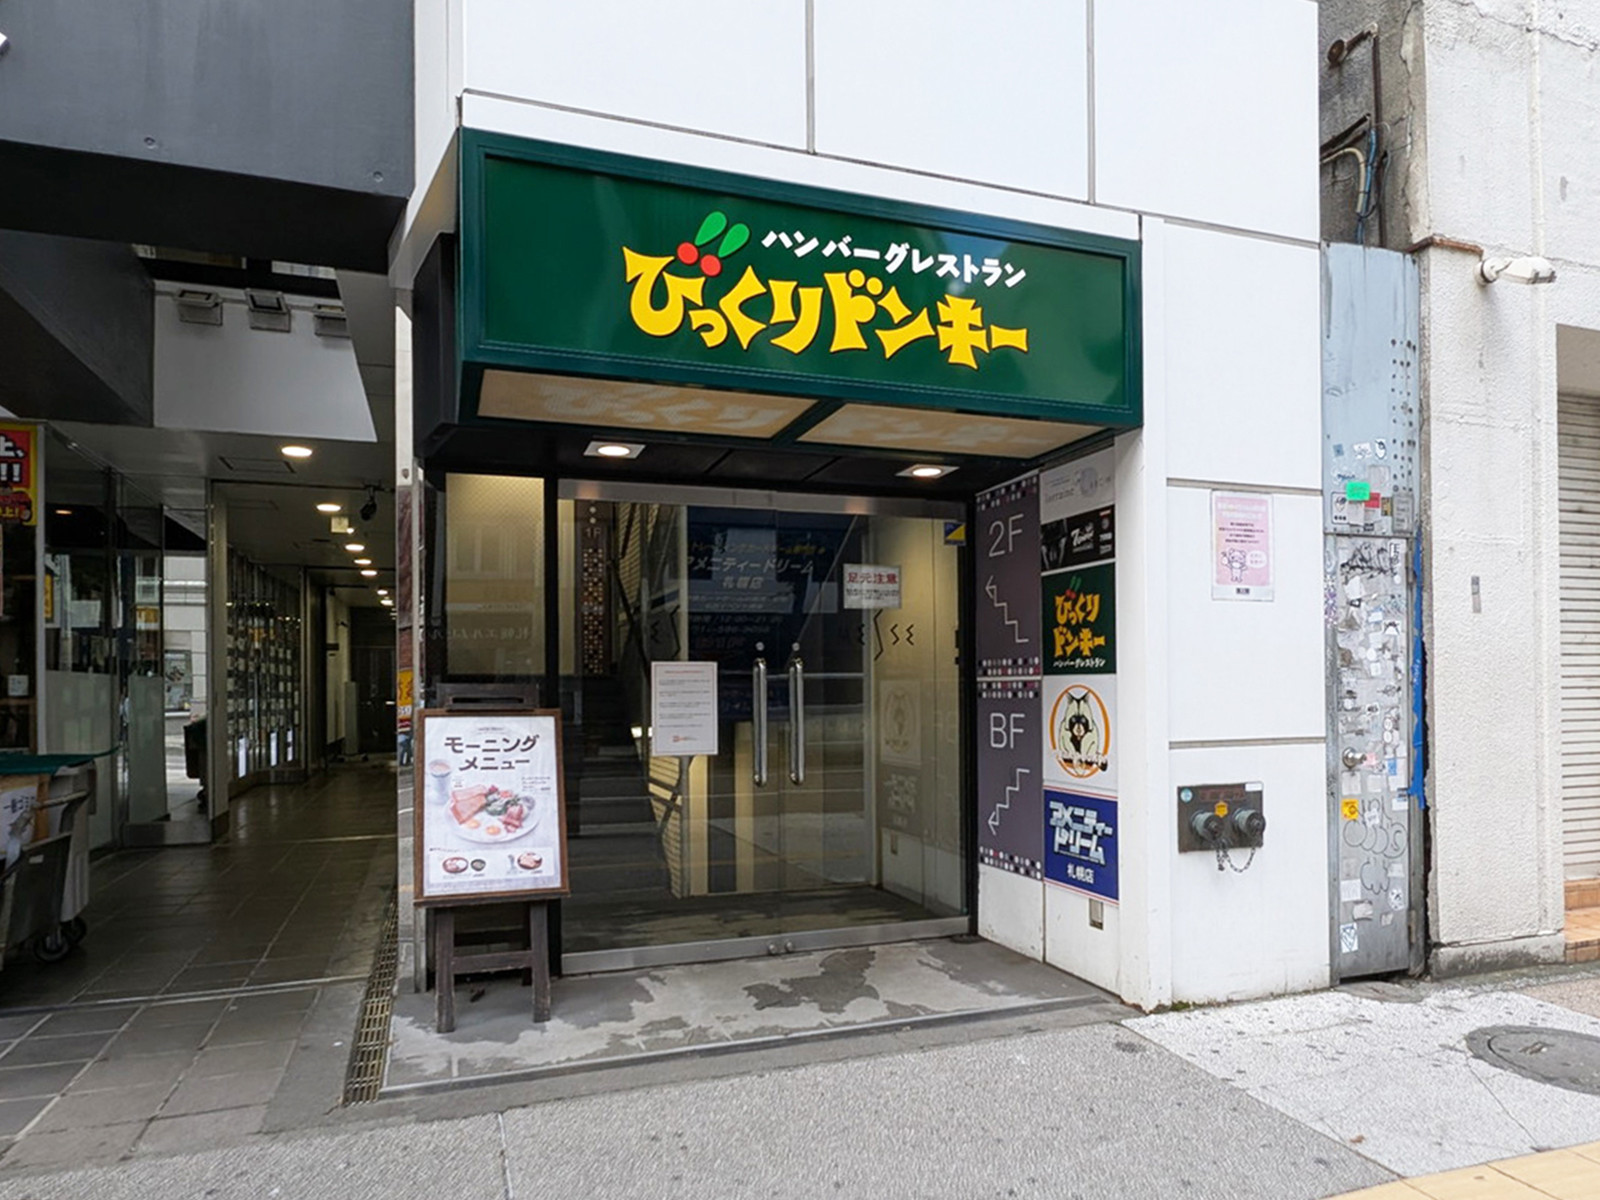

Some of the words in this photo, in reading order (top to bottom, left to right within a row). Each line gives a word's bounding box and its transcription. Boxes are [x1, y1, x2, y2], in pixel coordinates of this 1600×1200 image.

[761, 231, 1027, 288] ハンバーグレストラン
[622, 246, 1029, 370] びっくりドンキー
[988, 514, 1024, 558] 2F
[848, 571, 898, 585] 足元注意
[1055, 592, 1100, 626] びっくり
[1053, 625, 1105, 658] ドンキー
[444, 734, 540, 754] モーニング
[990, 712, 1025, 749] BF
[459, 756, 530, 772] メニュー
[1053, 826, 1106, 866] ドリーム
[1066, 862, 1095, 885] 札幌店
